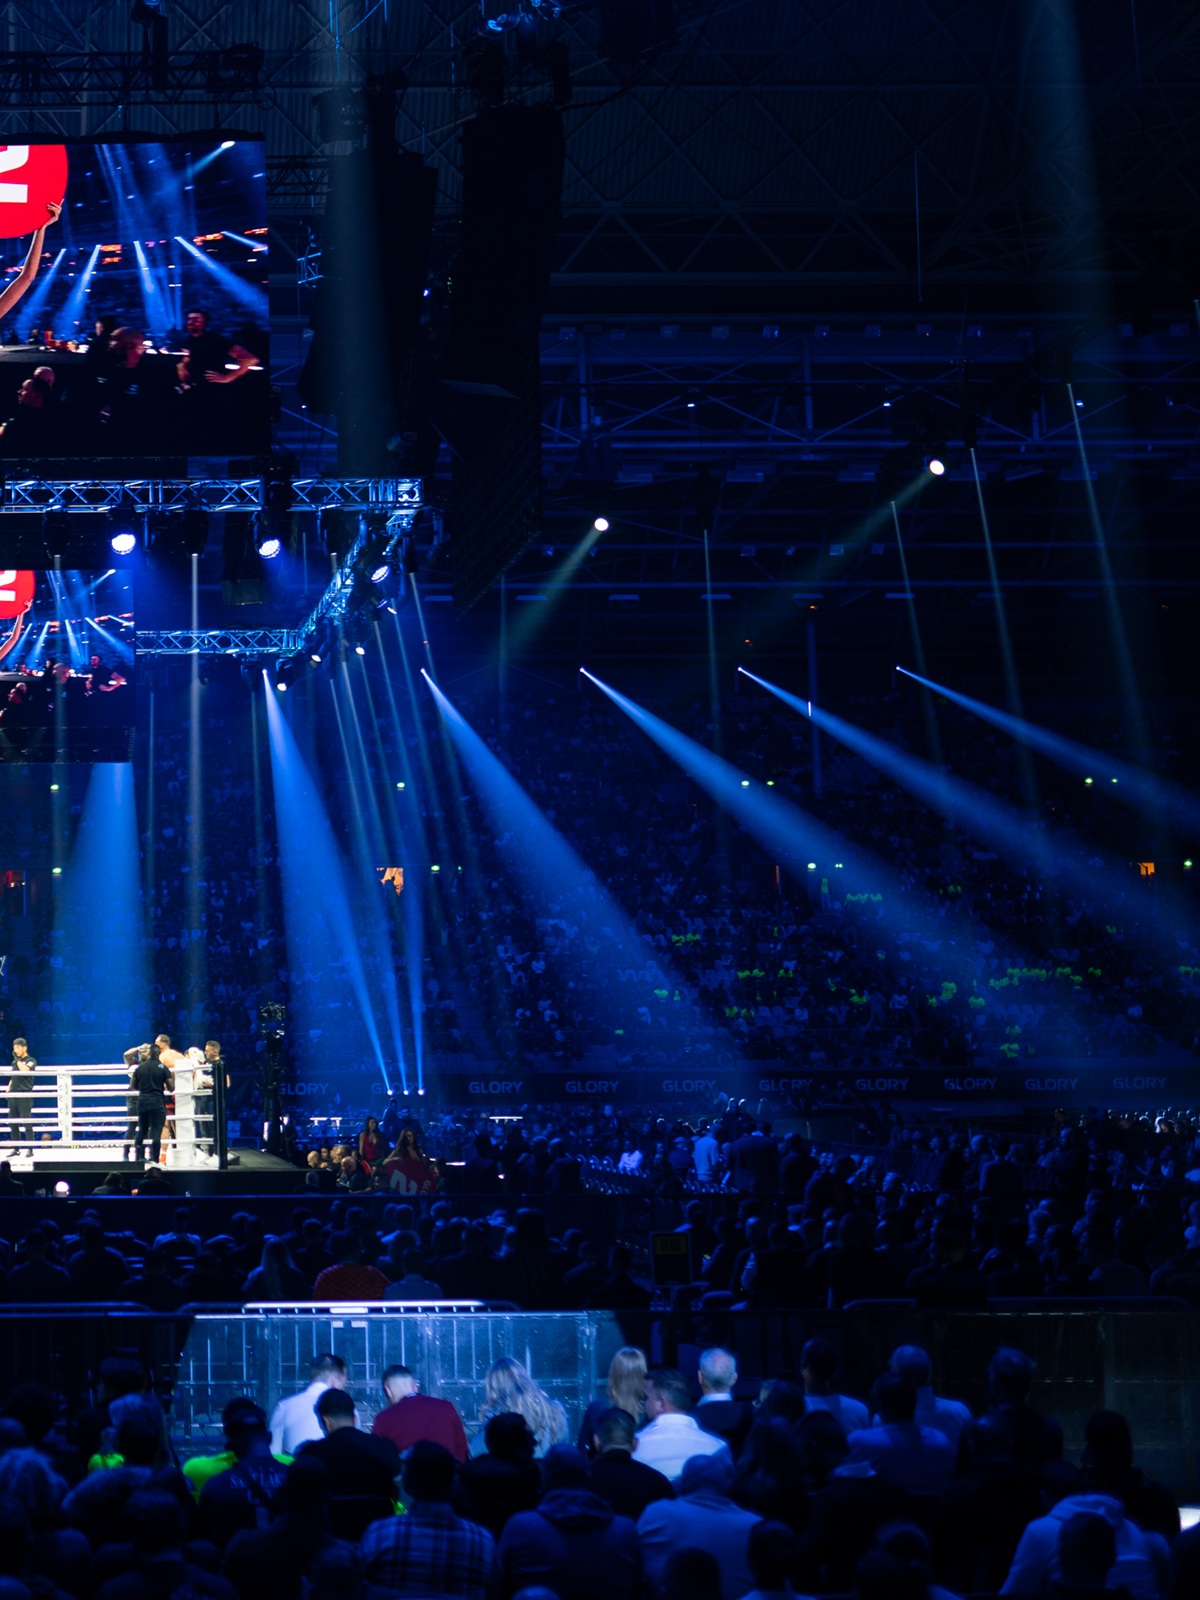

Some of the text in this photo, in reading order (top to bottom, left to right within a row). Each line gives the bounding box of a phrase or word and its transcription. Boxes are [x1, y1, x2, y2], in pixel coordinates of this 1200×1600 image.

[468, 1081, 522, 1094] GLORY
[565, 1080, 619, 1093] GLORY
[662, 1080, 716, 1092] GLORY
[855, 1078, 909, 1091] GLORY
[944, 1077, 997, 1090] GLORY
[1025, 1078, 1078, 1091] GLORY
[1113, 1077, 1166, 1089] GLORY
[660, 1239, 680, 1252] 010
